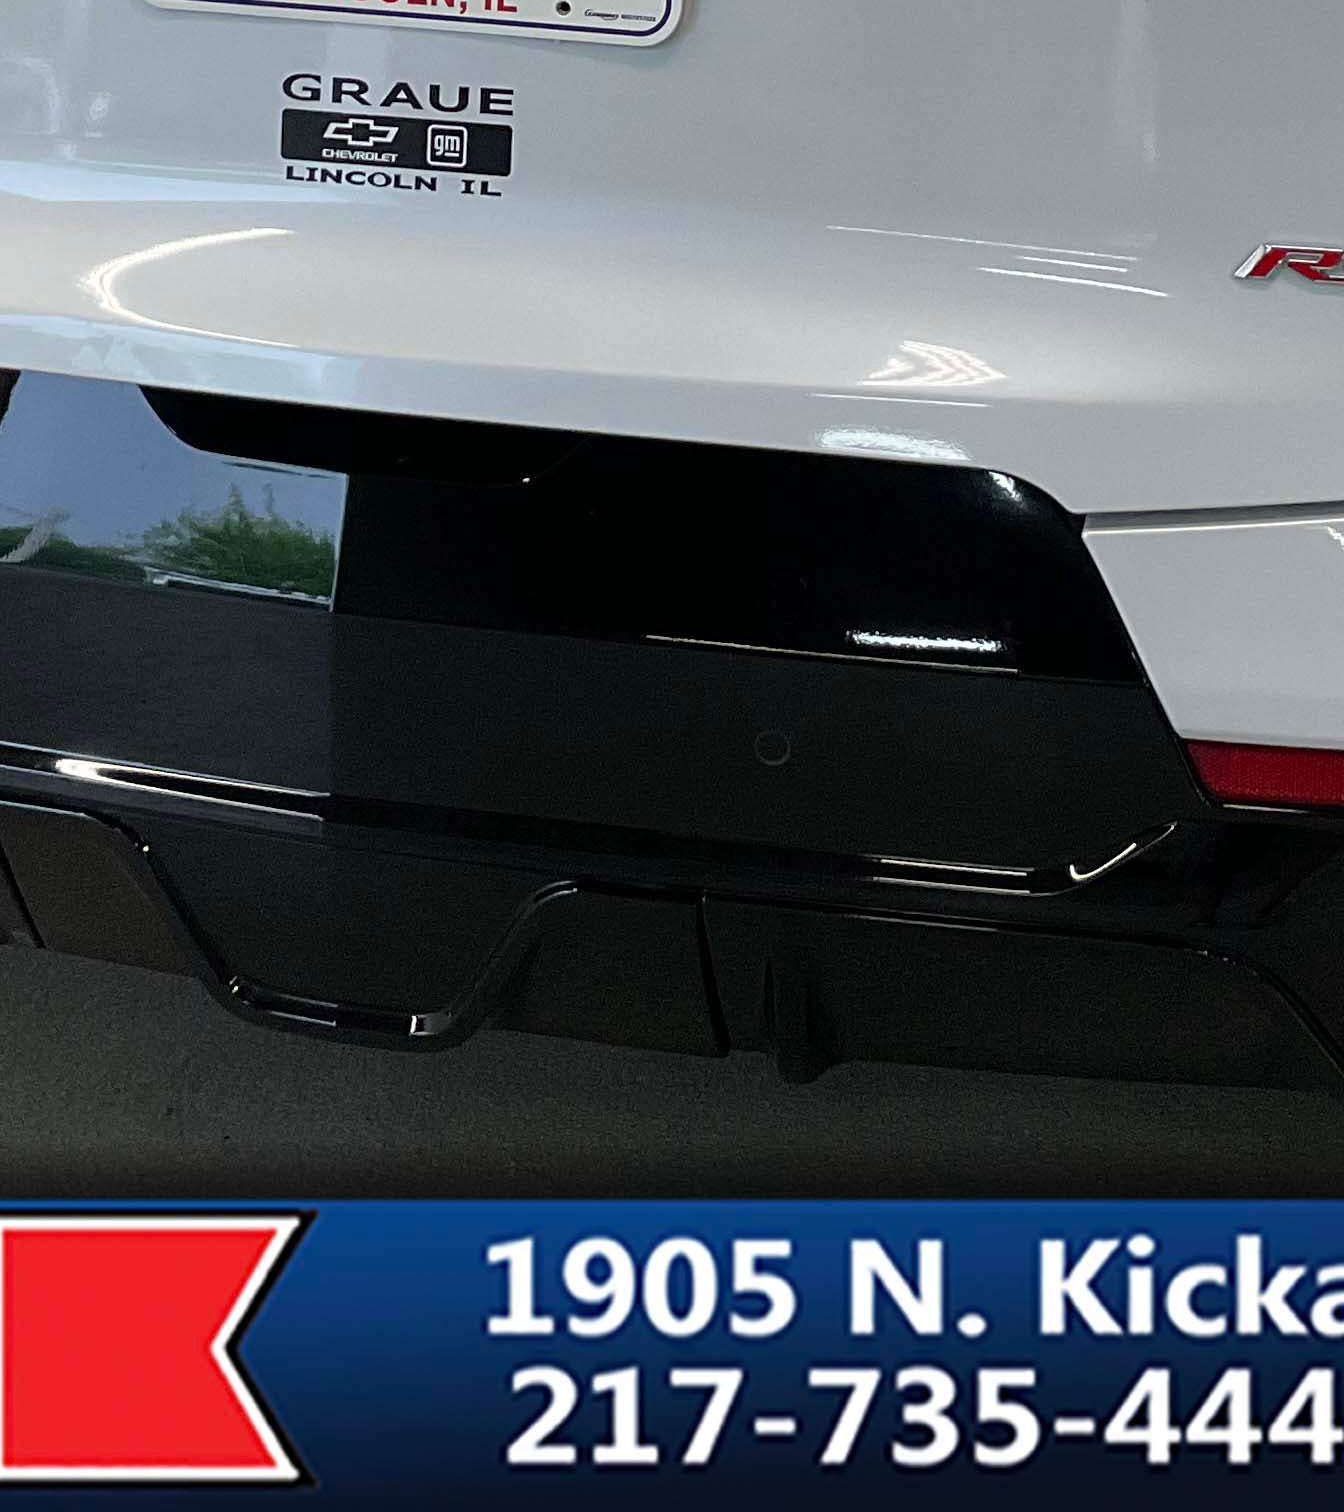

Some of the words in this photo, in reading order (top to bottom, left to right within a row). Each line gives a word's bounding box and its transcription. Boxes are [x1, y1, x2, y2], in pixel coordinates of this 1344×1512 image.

[282, 73, 514, 116] GRAUE
[322, 148, 399, 163] CHEVROLET
[433, 135, 461, 158] gm
[286, 166, 437, 192] LINCOLN
[460, 180, 503, 197] IL
